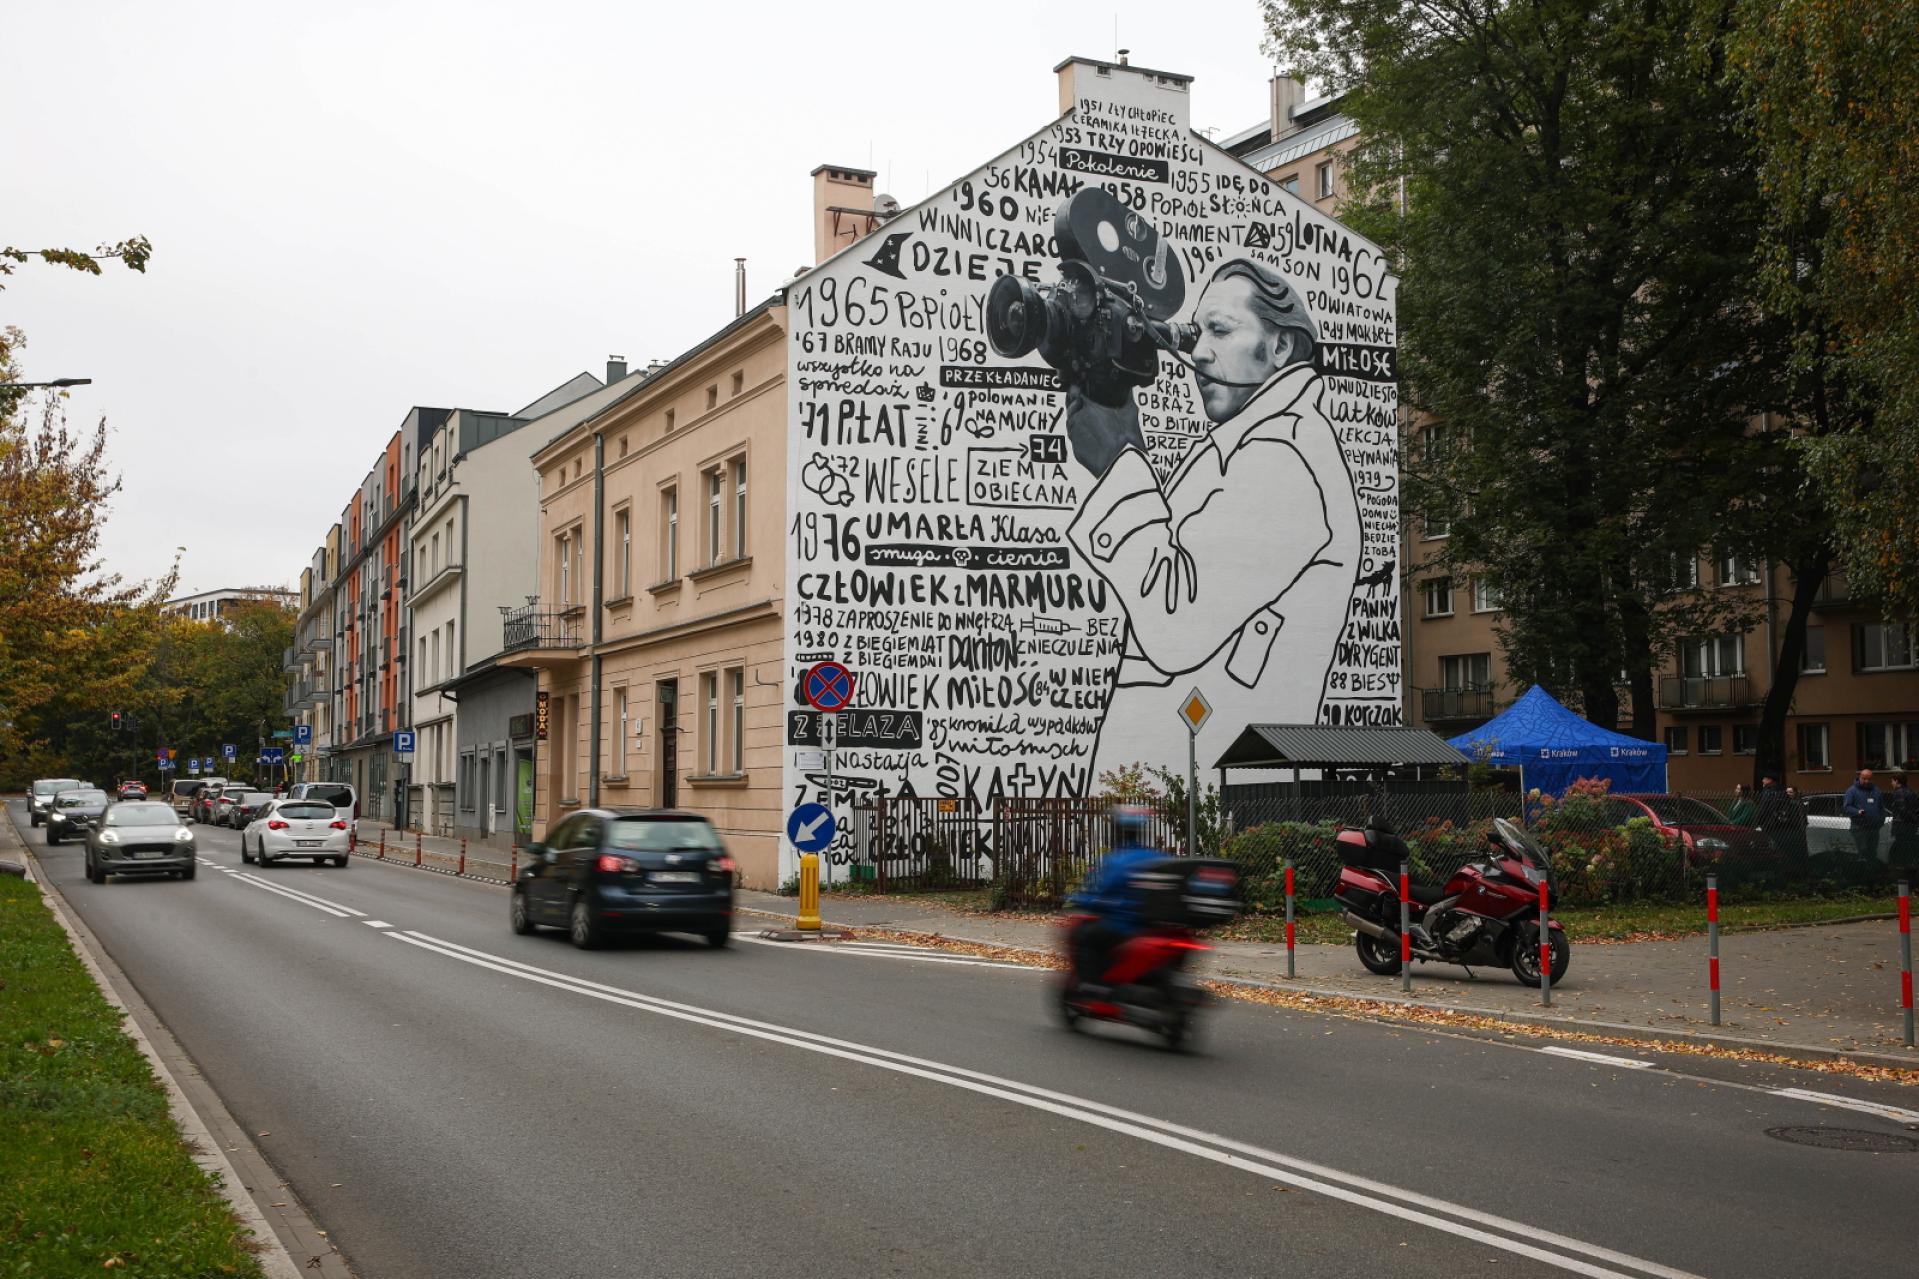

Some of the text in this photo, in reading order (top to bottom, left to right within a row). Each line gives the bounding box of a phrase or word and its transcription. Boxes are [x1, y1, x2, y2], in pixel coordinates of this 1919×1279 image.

[1080, 98, 1102, 115] 1951
[1072, 114, 1128, 135] CERAMIKA
[1051, 124, 1082, 144] 1953
[1086, 132, 1126, 155] TRZY
[1019, 140, 1160, 181] 1954 Pokolenie
[1171, 170, 1211, 195] 1955
[1250, 178, 1270, 196] DO
[953, 180, 1019, 221] 1960
[1162, 220, 1246, 246] DIAMENT
[798, 276, 889, 328] 1965
[1306, 290, 1393, 325] POWIATOWA
[834, 332, 887, 357] BRAMY
[891, 335, 932, 358] RAJU
[938, 335, 987, 365] 1968
[890, 358, 925, 378] na
[945, 368, 1062, 389] PRZEKŁADANIEC
[1157, 379, 1191, 398] KRAJ
[1137, 392, 1195, 415] OBRAZ
[998, 406, 1064, 433] MUCHY
[1142, 413, 1213, 434] PO BITWIE
[1146, 435, 1188, 450] BRZE
[1339, 427, 1392, 447] LEKCJA
[977, 459, 1069, 481] ZIEMIA
[1151, 451, 1183, 469] ZINA
[865, 454, 960, 504] WESELE
[974, 481, 1078, 505] OBIECANA
[790, 511, 861, 561] 1976
[866, 511, 986, 541] UMARŁA
[869, 549, 1064, 567] smuga cienia
[798, 569, 949, 607] CZŁOWIEK
[966, 571, 1107, 614] MARMURU
[1352, 595, 1398, 620] PANNY
[836, 609, 934, 634] ZAPROSZENIE
[938, 612, 951, 631] DO
[1086, 617, 1120, 637] BEZ
[857, 635, 919, 654] BIEGIEM
[859, 651, 918, 670] BIEGIEM
[845, 671, 940, 710] ZŁOWIEK
[1551, 749, 1578, 758] Kraków
[1620, 748, 1648, 757] Kraków
